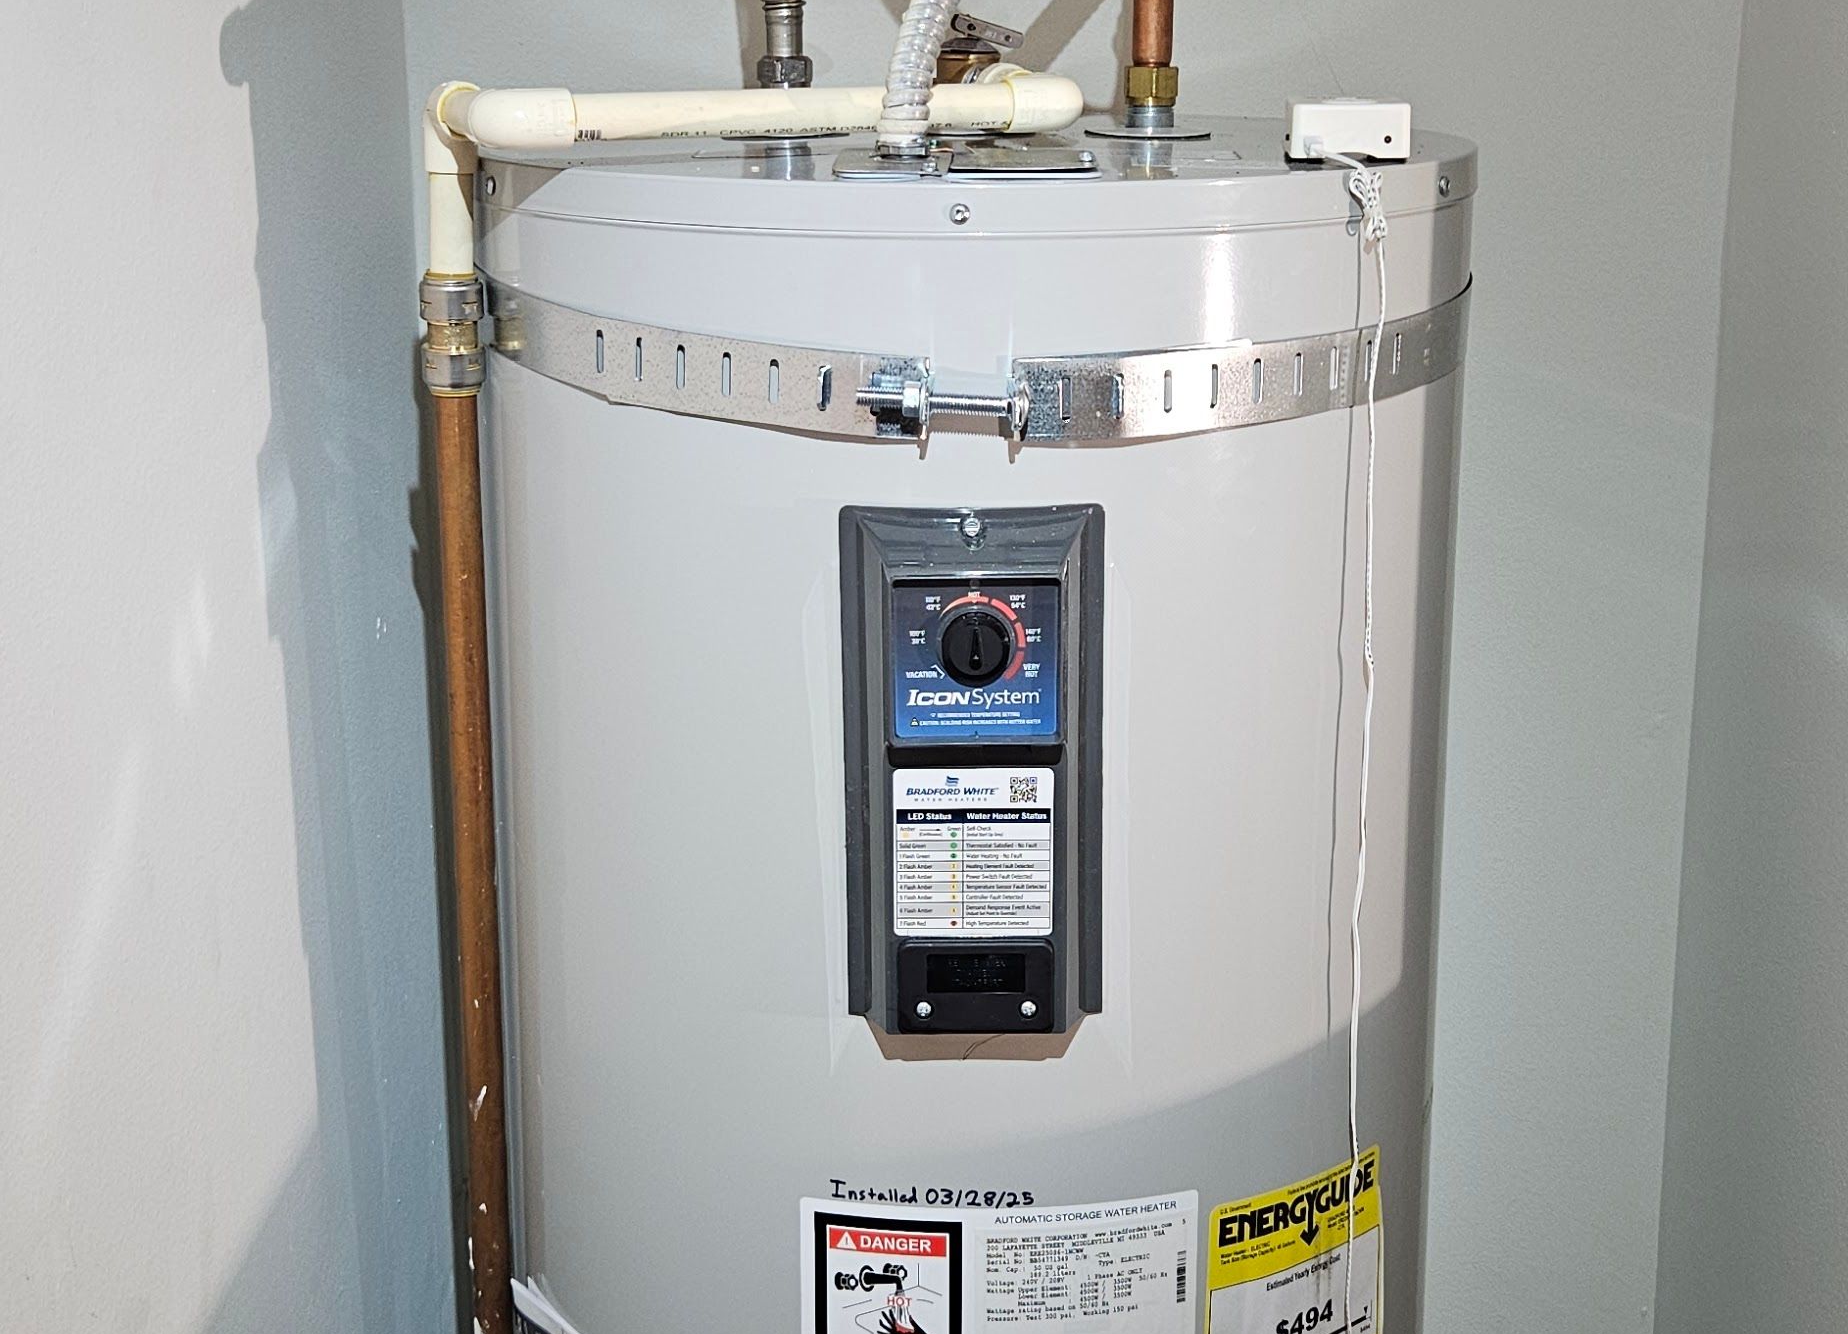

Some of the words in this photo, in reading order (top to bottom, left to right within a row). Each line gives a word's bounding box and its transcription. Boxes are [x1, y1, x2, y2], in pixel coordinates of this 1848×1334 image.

[1023, 663, 1041, 671] VERY
[905, 670, 938, 679] VACATION
[1025, 670, 1039, 678] HOT
[906, 787, 961, 796] BRADFORD
[963, 787, 996, 796] WHITE
[907, 812, 924, 821] LED
[926, 812, 952, 821] Status
[966, 812, 991, 821] Water
[992, 812, 1020, 821] Heater
[1021, 812, 1048, 821] Status
[829, 1178, 918, 1204] Installed
[925, 1187, 1035, 1209] 03/28/25
[1218, 1158, 1375, 1248] ENERGYGUIDE
[994, 1214, 1053, 1225] AUTOMATIC
[1055, 1210, 1102, 1222] STORAGE
[1104, 1206, 1138, 1218] WATER
[1140, 1200, 1177, 1214] HEATER
[1045, 1233, 1088, 1243] CORPORATION
[860, 1234, 932, 1253] DANGER
[1002, 1243, 1038, 1251] LAFAYETTE
[1071, 1238, 1114, 1247] MIDDLEVILLE
[1120, 1253, 1150, 1263] ELECTRIC
[1266, 1274, 1294, 1292] Estimated
[1294, 1268, 1310, 1283] Yearly
[1329, 1253, 1341, 1266] Cost
[887, 1296, 913, 1307] HOT
